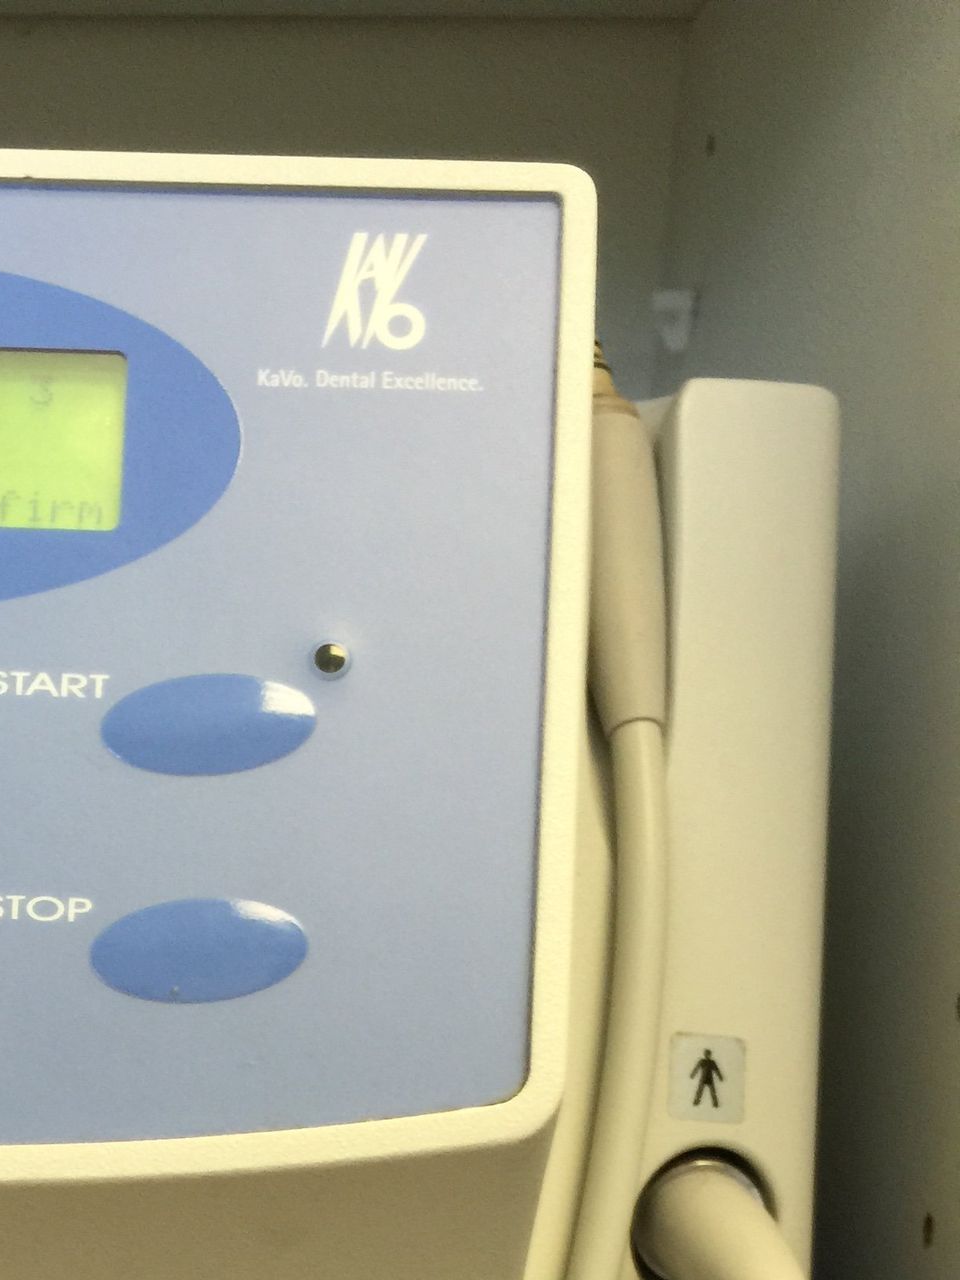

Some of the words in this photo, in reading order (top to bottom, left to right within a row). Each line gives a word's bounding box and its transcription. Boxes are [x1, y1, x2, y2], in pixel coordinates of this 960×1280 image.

[256, 369, 309, 388] KaVo.
[316, 370, 375, 389] Dental
[381, 371, 484, 391] Excellence.
